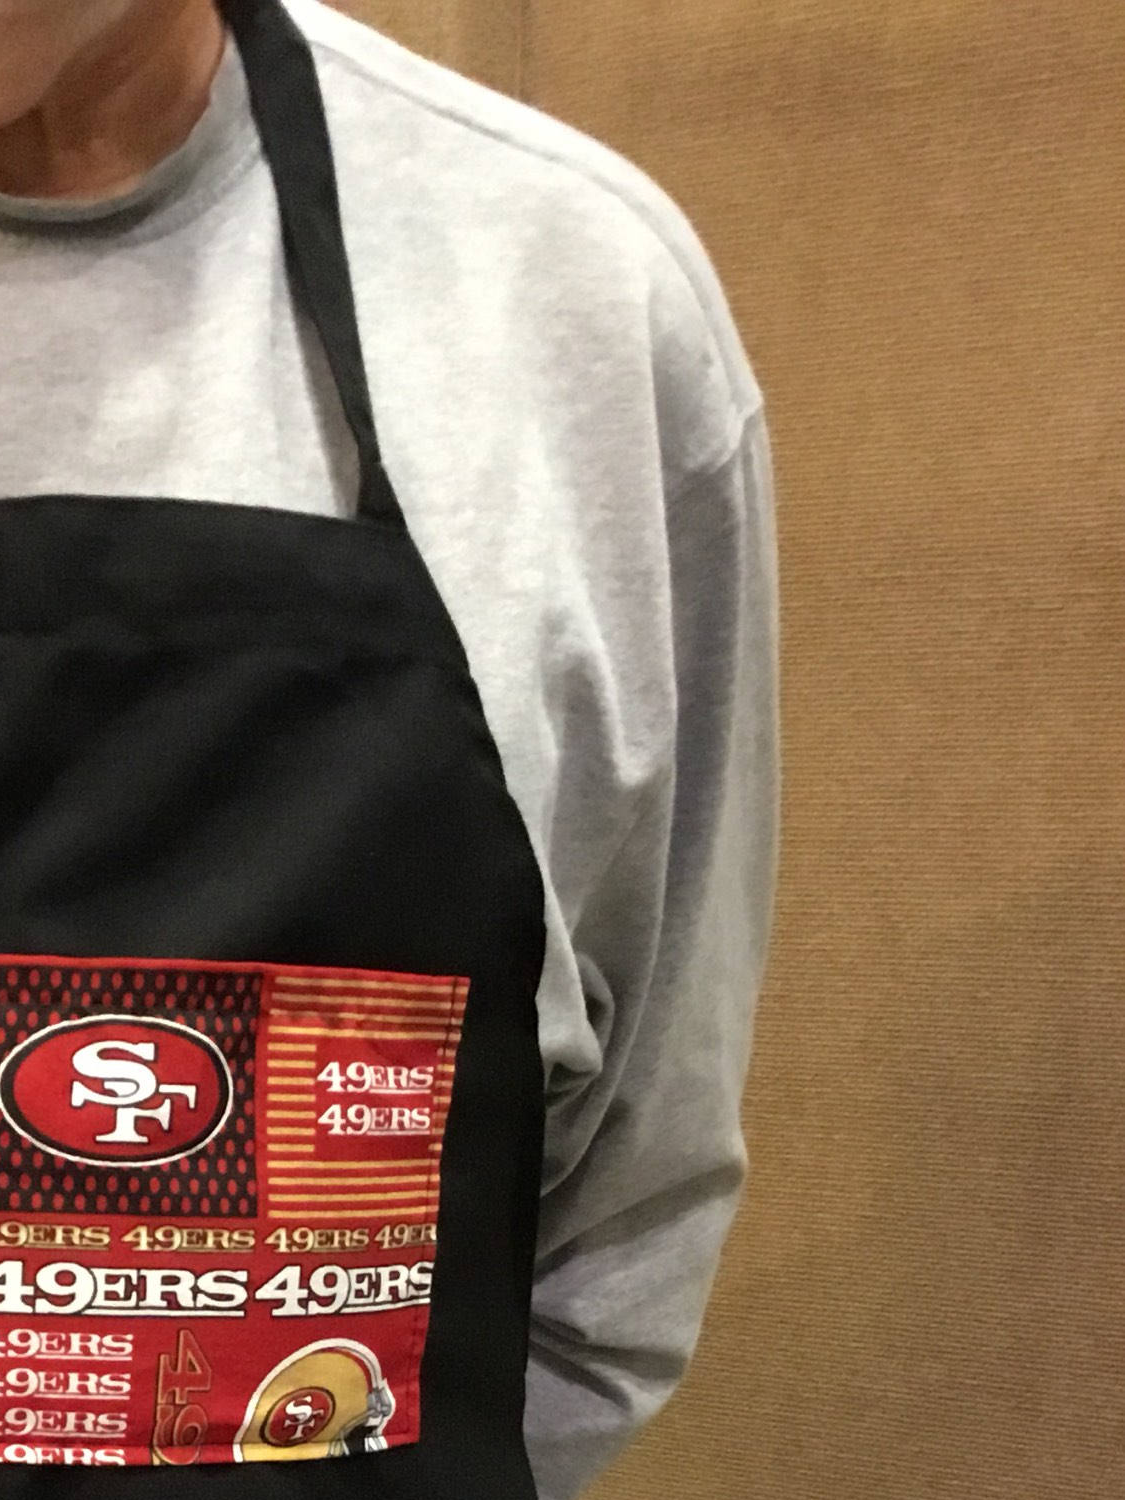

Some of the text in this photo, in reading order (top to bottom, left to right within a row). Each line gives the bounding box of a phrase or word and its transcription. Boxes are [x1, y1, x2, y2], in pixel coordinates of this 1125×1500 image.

[71, 1040, 197, 1144] SF
[317, 1061, 434, 1094] 49ERS
[317, 1103, 431, 1136] 49ERS
[121, 1225, 256, 1253] 49ERS
[264, 1227, 369, 1253] 49ERS
[255, 1262, 435, 1317] 49ERS
